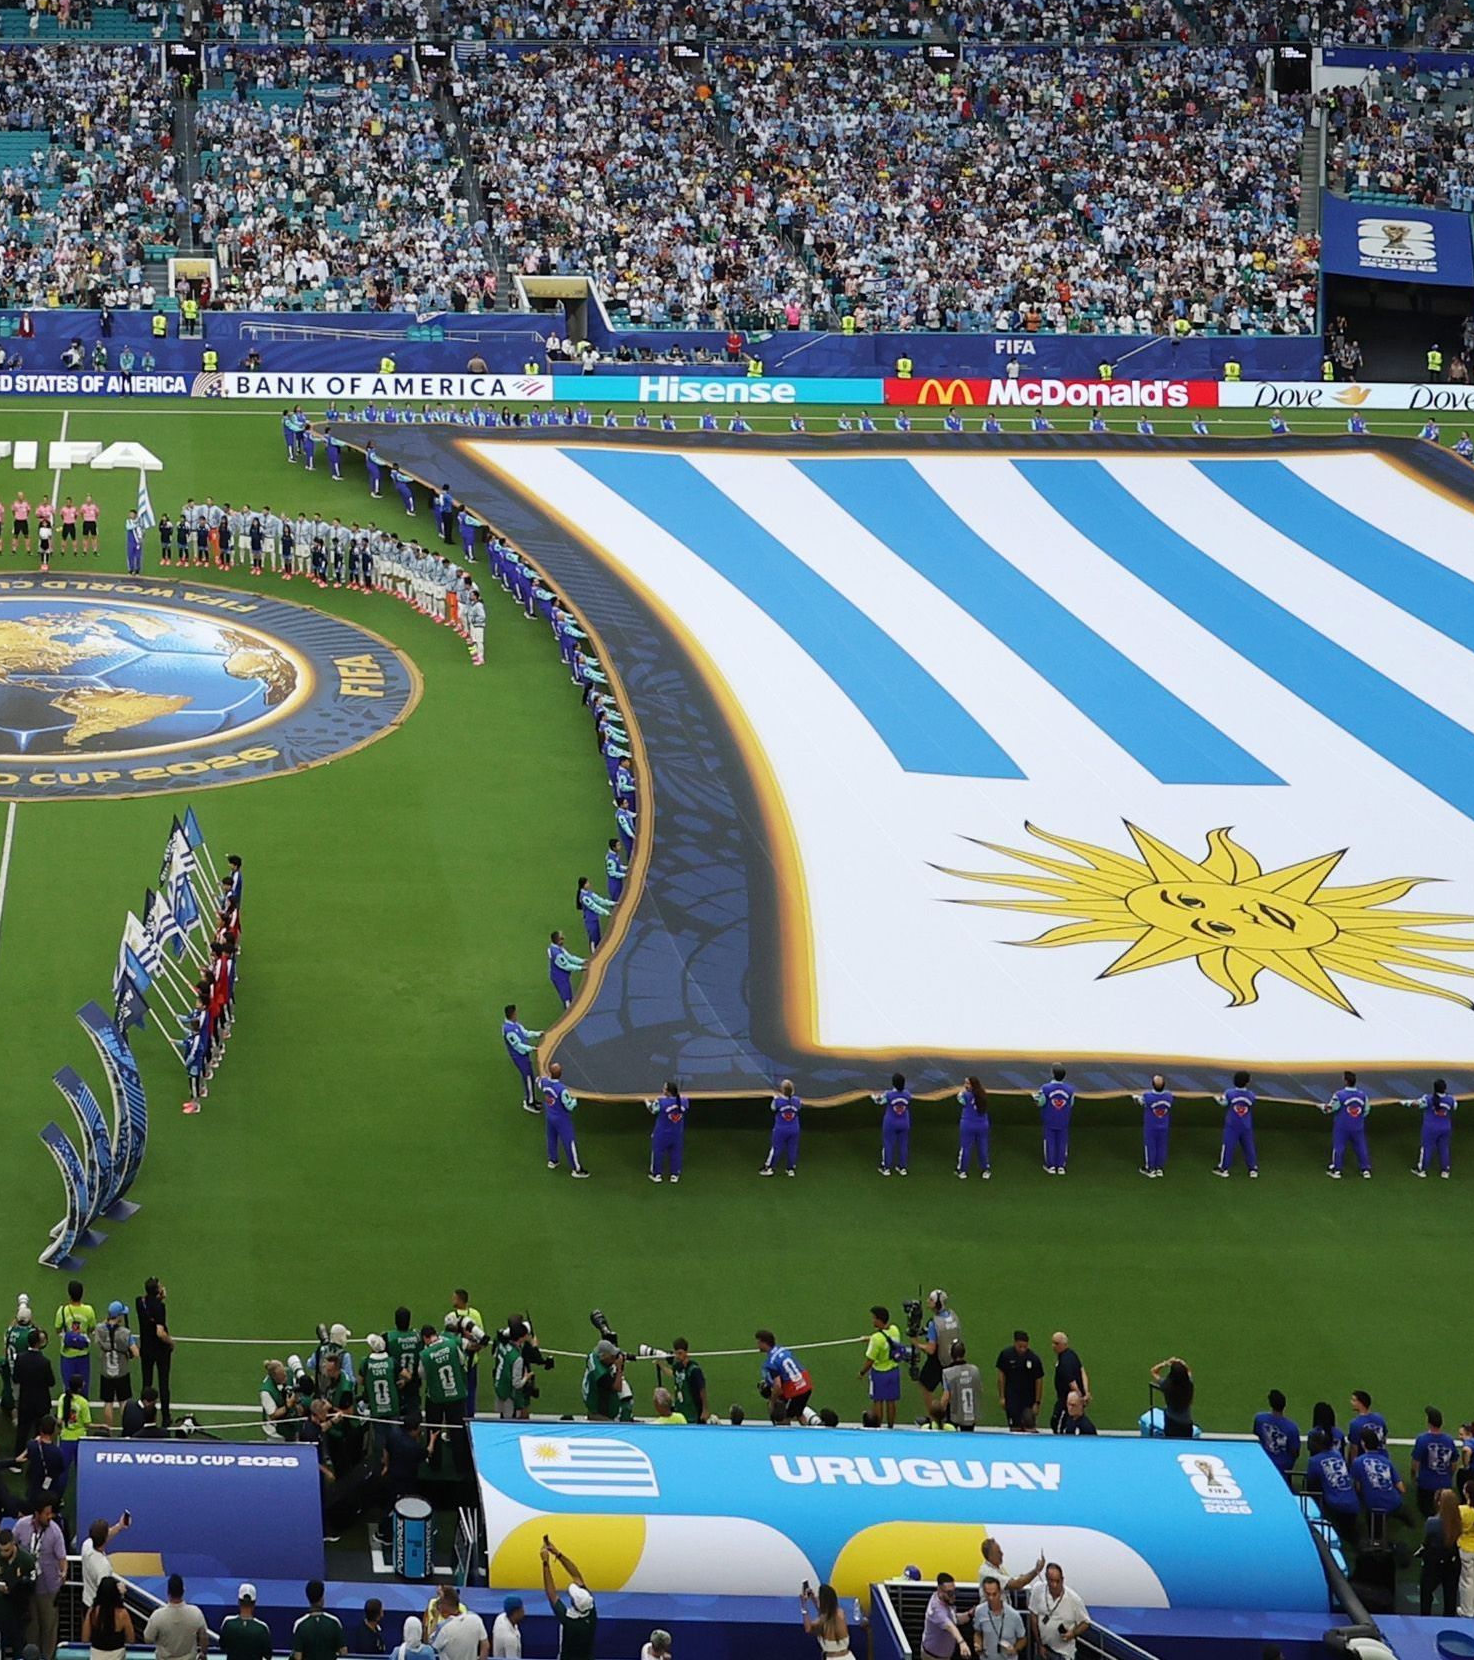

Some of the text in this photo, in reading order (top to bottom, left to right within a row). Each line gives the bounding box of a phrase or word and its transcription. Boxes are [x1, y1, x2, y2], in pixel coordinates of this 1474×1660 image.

[1358, 256, 1409, 265] WORLD
[1381, 249, 1415, 257] FIFA
[995, 338, 1036, 356] FIFA
[14, 373, 79, 394] STATES
[80, 374, 105, 395] OF
[107, 374, 188, 395] AMERICA
[236, 376, 509, 398] BANK OF AMERICA
[639, 377, 796, 405] Hisense
[987, 380, 1189, 409] McDonald's
[1253, 383, 1324, 411] Dove
[41, 580, 174, 598] WORLD
[183, 592, 258, 614] FIFA
[339, 652, 386, 699] FIFA
[28, 769, 121, 787] CUP
[129, 744, 282, 781] 2026
[96, 1452, 300, 1468] FIFA WORLD CUP 2026
[768, 1453, 1062, 1492] URUGUAY
[1207, 1487, 1231, 1495] FIFA
[1204, 1504, 1253, 1515] 2026
[396, 1517, 405, 1574] POWERADE
